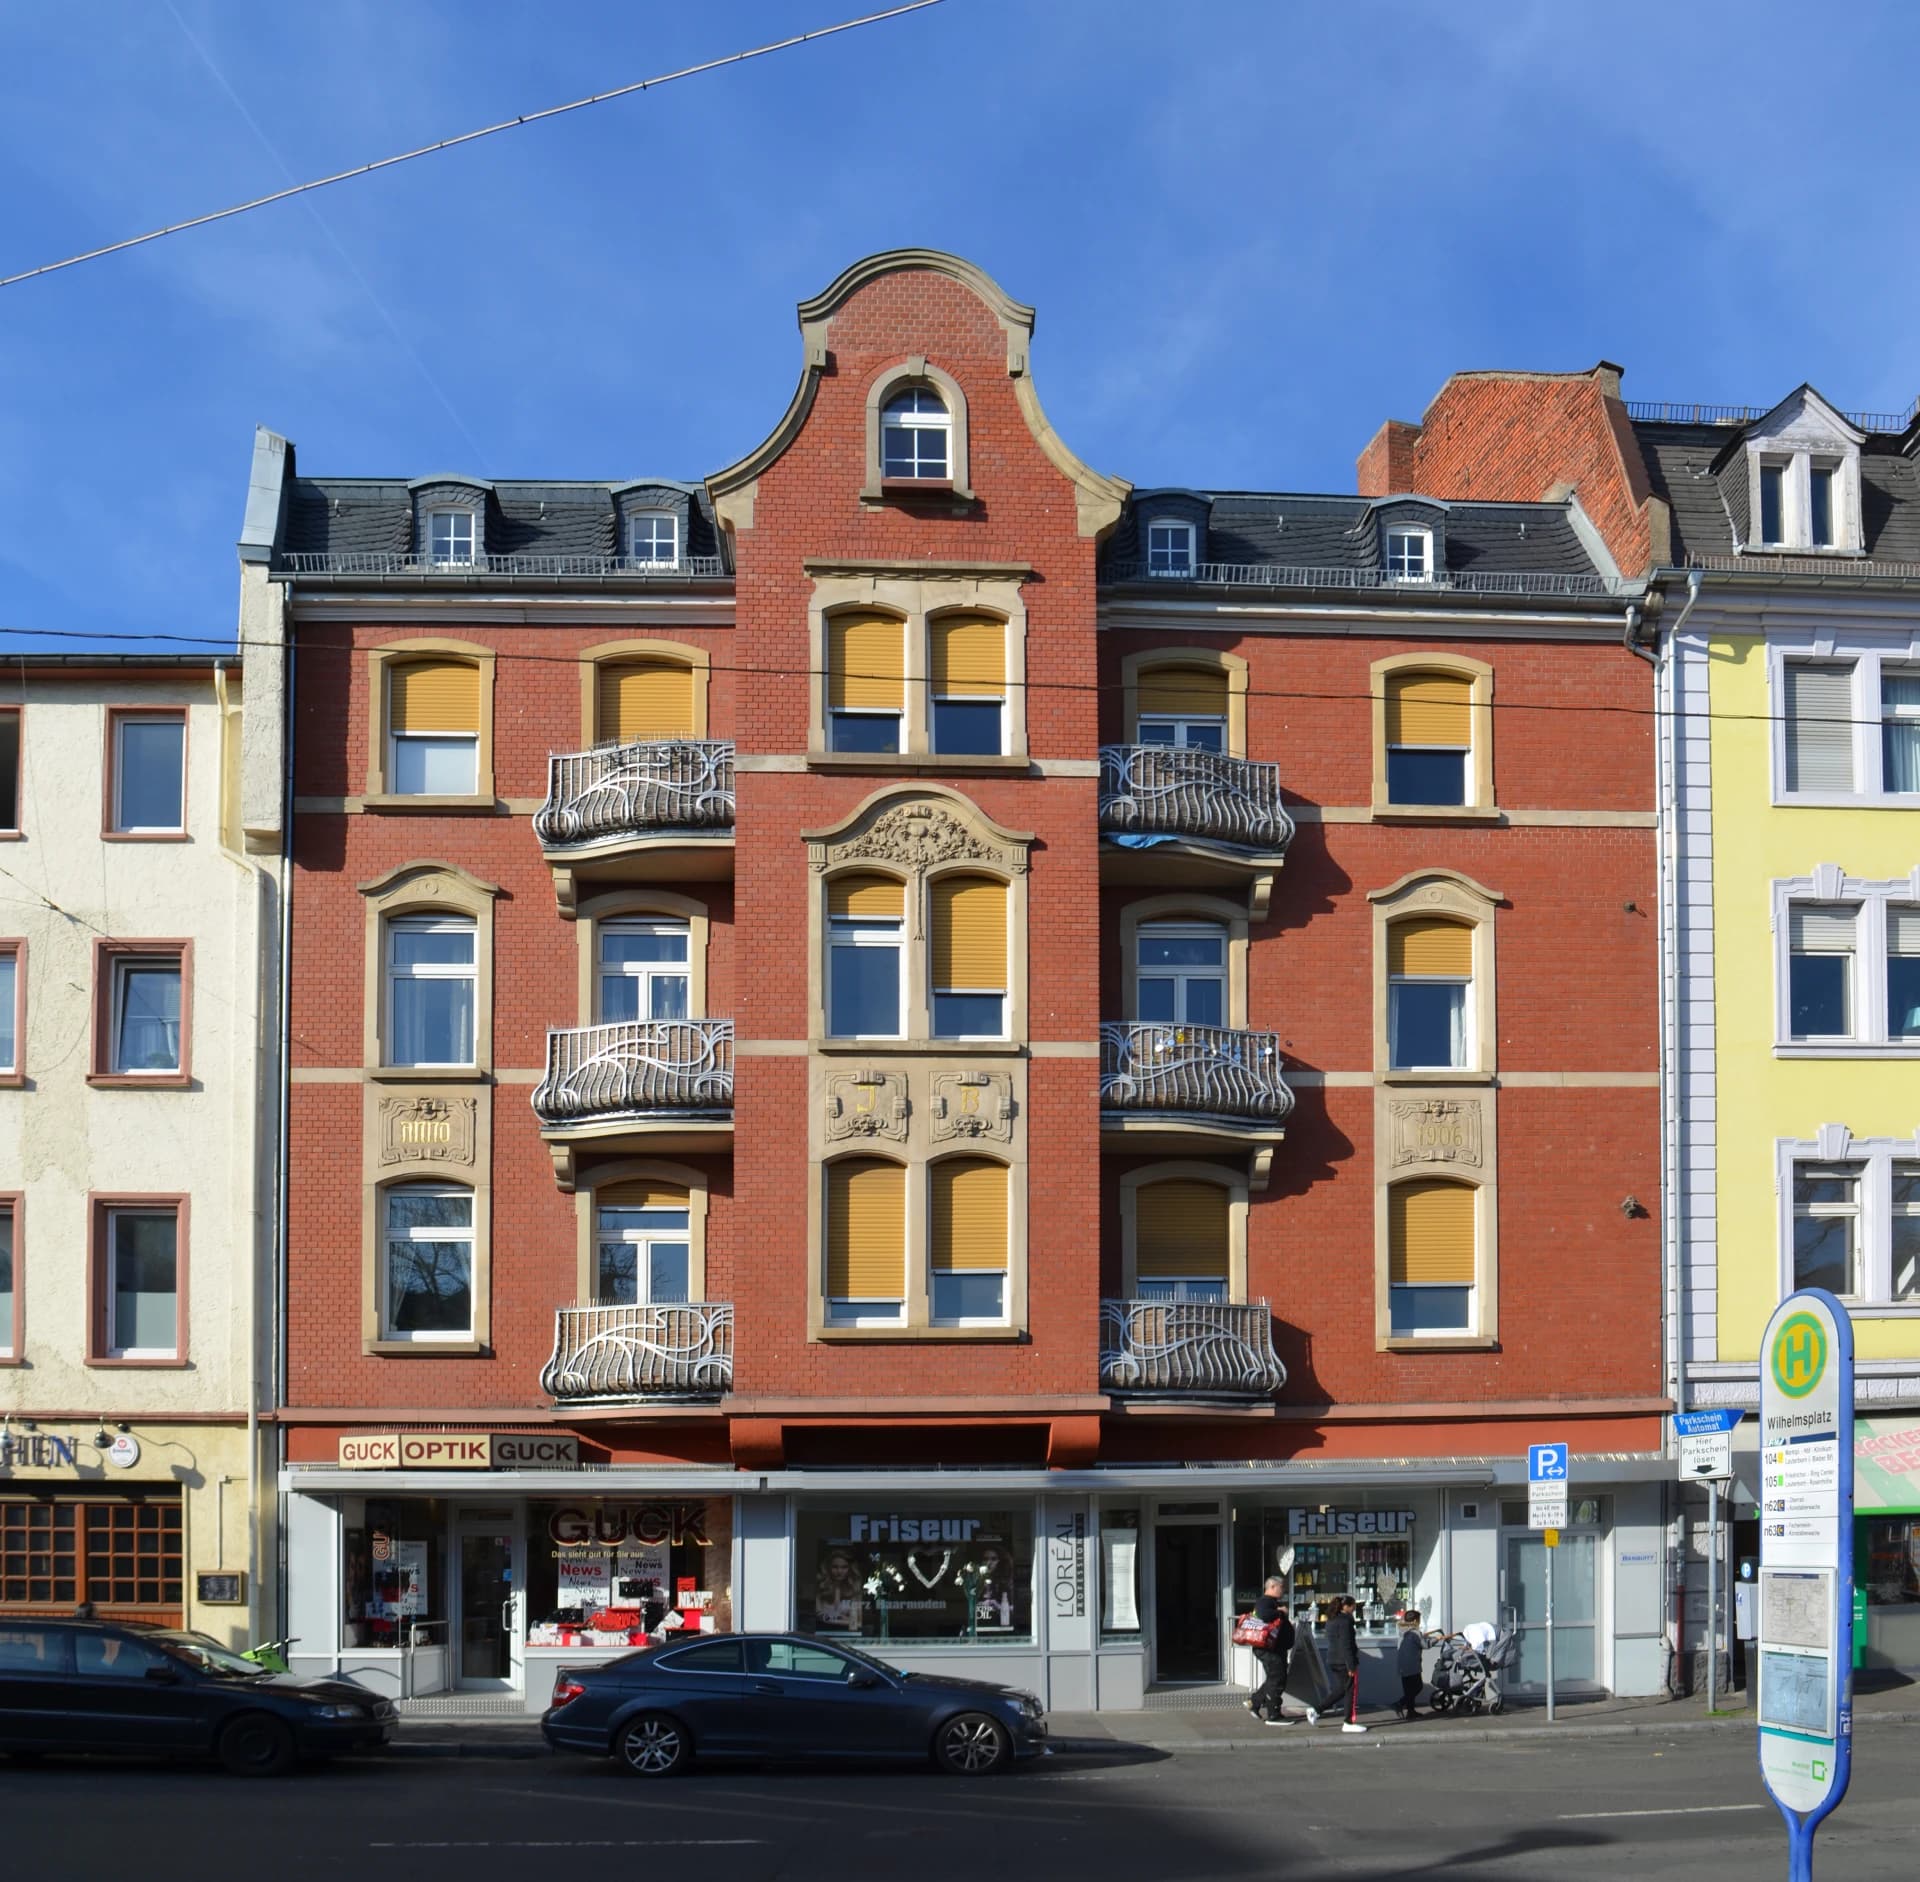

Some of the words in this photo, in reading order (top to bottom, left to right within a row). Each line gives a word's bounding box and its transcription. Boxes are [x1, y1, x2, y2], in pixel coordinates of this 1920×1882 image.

[1418, 1126, 1463, 1147] 1906
[1786, 1331, 1811, 1379] H
[1680, 1413, 1722, 1425] Parkschein
[1767, 1410, 1832, 1430] Wilhelmsplatz
[1688, 1422, 1720, 1433] Automat
[1696, 1438, 1712, 1446] Hier
[343, 1442, 396, 1461] GUCK
[404, 1441, 487, 1460] OPTIK
[499, 1441, 573, 1461] GUCK
[1683, 1446, 1727, 1455] Parkschein
[1537, 1449, 1558, 1477] P
[1765, 1453, 1777, 1464] 104
[1765, 1475, 1778, 1487] 105
[1764, 1500, 1778, 1512] n62
[549, 1505, 714, 1547] GUCK
[1287, 1507, 1416, 1536] Friseur
[850, 1514, 981, 1542] Friseur
[1764, 1525, 1777, 1537] n63
[568, 1550, 587, 1558] sieht
[588, 1551, 601, 1559] gut
[560, 1564, 602, 1576] News
[635, 1561, 663, 1569] News
[1051, 1512, 1075, 1617] L'ORÉAL
[875, 1599, 947, 1609] Haarmoden
